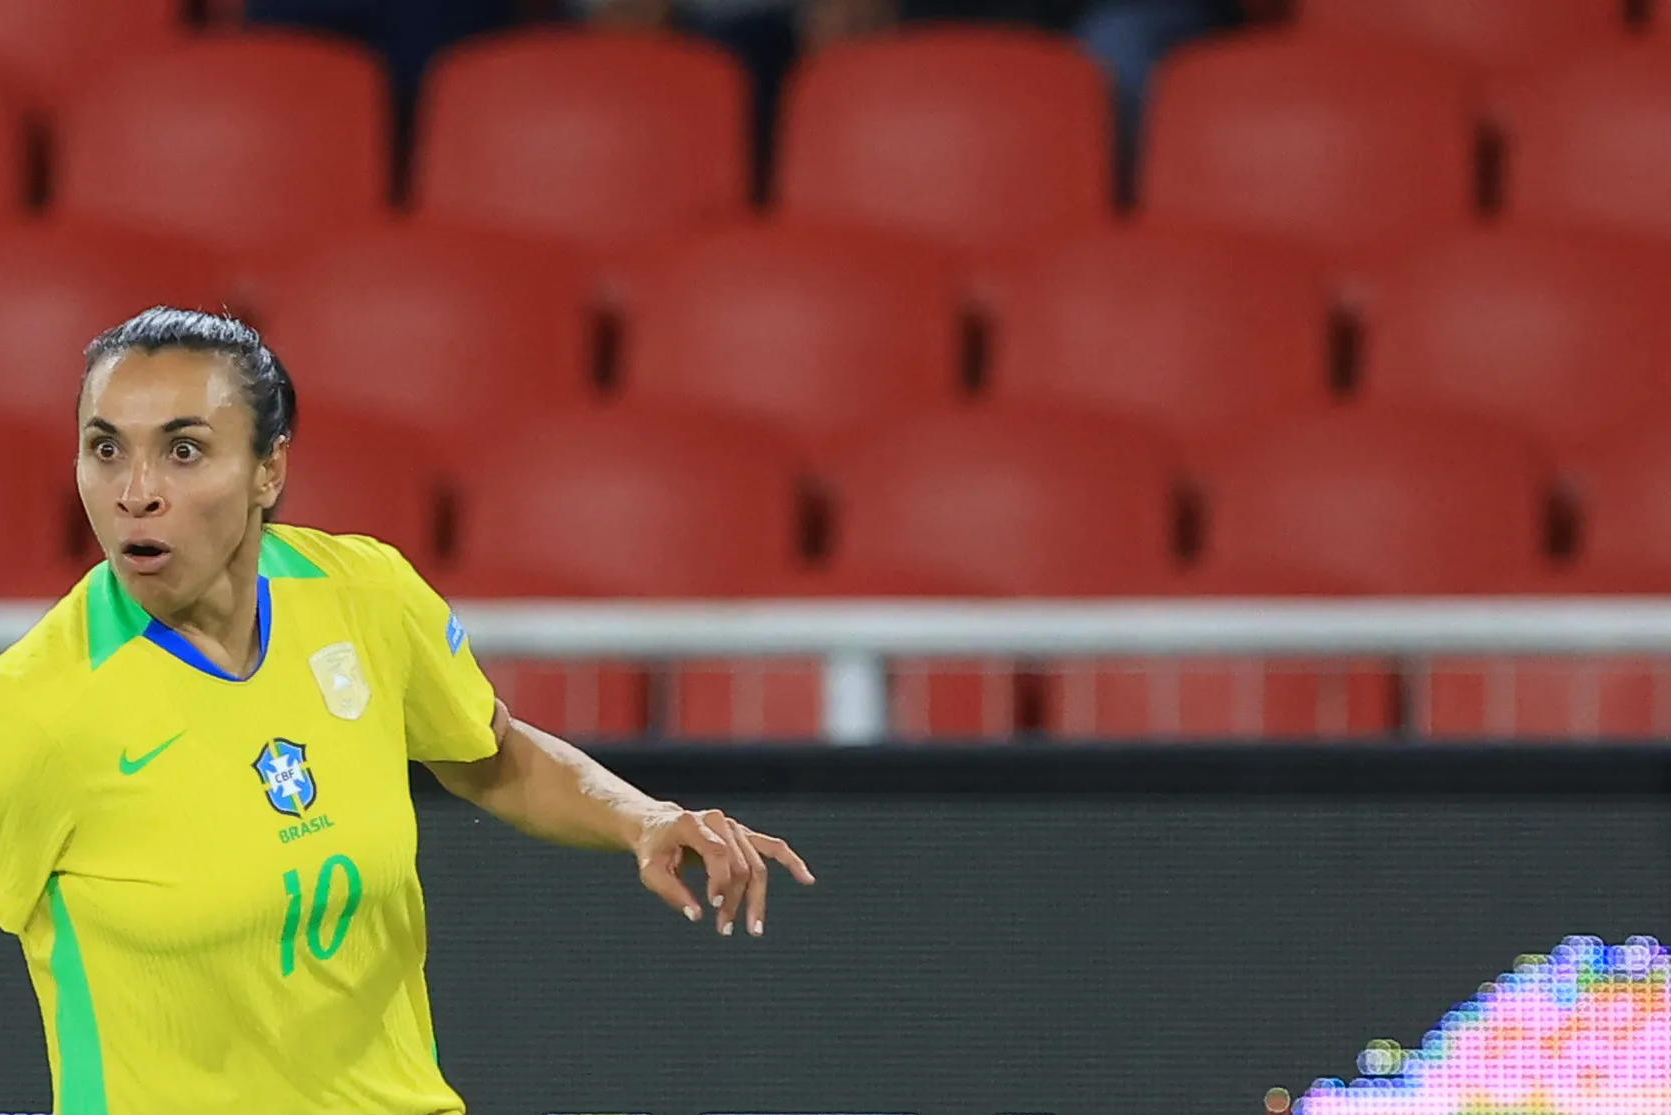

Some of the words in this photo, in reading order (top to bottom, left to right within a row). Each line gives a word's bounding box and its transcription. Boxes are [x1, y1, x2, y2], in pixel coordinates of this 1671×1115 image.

[274, 768, 295, 784] CBF
[278, 814, 335, 844] BRASIL
[280, 853, 363, 977] 10
